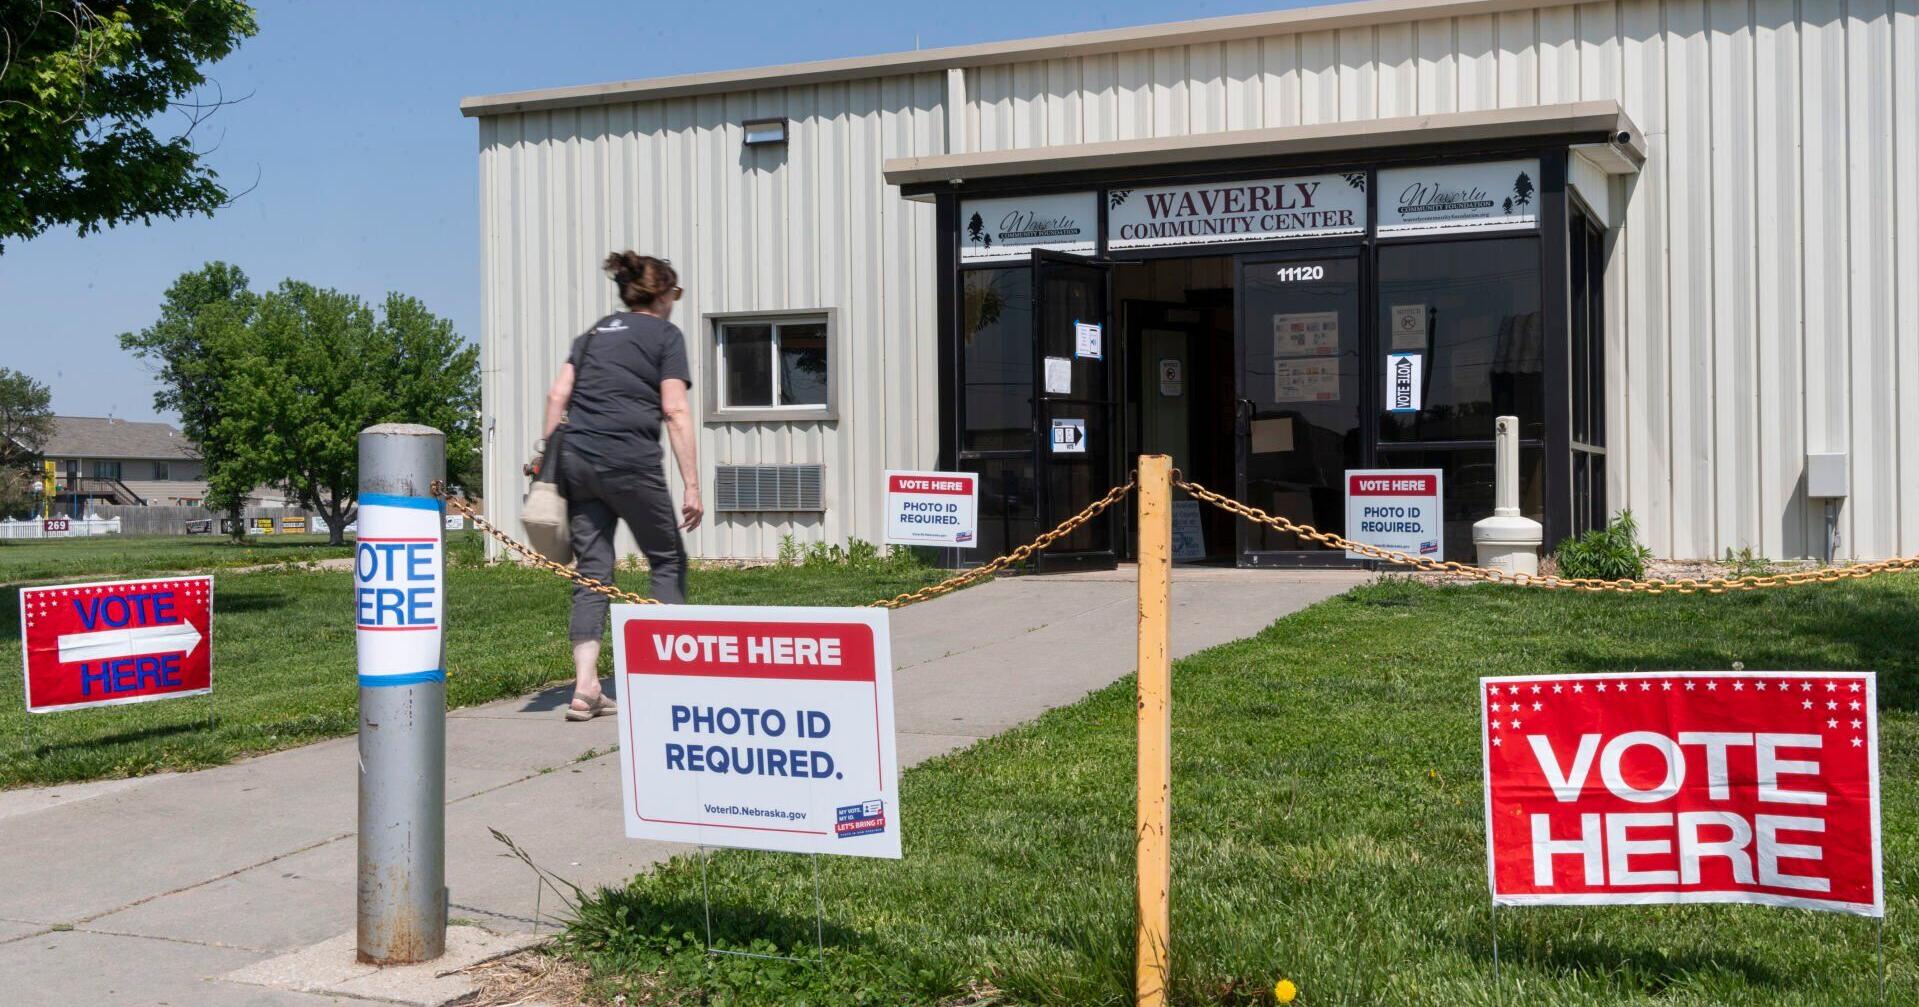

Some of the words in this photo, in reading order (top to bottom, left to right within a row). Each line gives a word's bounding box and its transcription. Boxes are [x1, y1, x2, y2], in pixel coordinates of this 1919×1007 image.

[1144, 182, 1320, 219] WAVERLY
[1400, 182, 1487, 206] Waverly
[1400, 204, 1443, 213] COMMUNITY
[1444, 201, 1491, 210] FOUNDATION
[1000, 210, 1075, 233] Waverly
[1120, 216, 1254, 240] COMMUNITY
[1260, 209, 1355, 232] CENTER
[1001, 231, 1038, 239] COMMUNITY
[1277, 265, 1323, 281] 11120
[1398, 363, 1411, 384] VOTE
[1397, 386, 1410, 407] VOTE
[899, 480, 929, 490] VOTE
[931, 481, 963, 491] HERE
[1360, 480, 1390, 491] VOTE
[1392, 480, 1426, 491] HERE
[903, 502, 943, 512] PHOTO
[946, 503, 957, 513] ID
[1364, 507, 1404, 518] PHOTO
[1408, 507, 1420, 518] ID
[48, 521, 66, 530] 269
[900, 514, 960, 525] REQUIRED.
[1361, 521, 1424, 533] REQUIRED.
[357, 543, 435, 582] OTE
[73, 592, 178, 630] VOTE
[357, 587, 435, 625] ERE
[652, 634, 739, 663] VOTE
[747, 637, 842, 666] HERE
[81, 655, 182, 696] HERE
[671, 705, 786, 737] PHOTO
[796, 710, 831, 739] ID
[665, 743, 843, 780] REQUIRED.
[1526, 731, 1827, 806] VOTE
[704, 803, 807, 821] VoterID.Nebraska.gov
[855, 820, 876, 828] BRING
[1531, 811, 1831, 893] HERE
